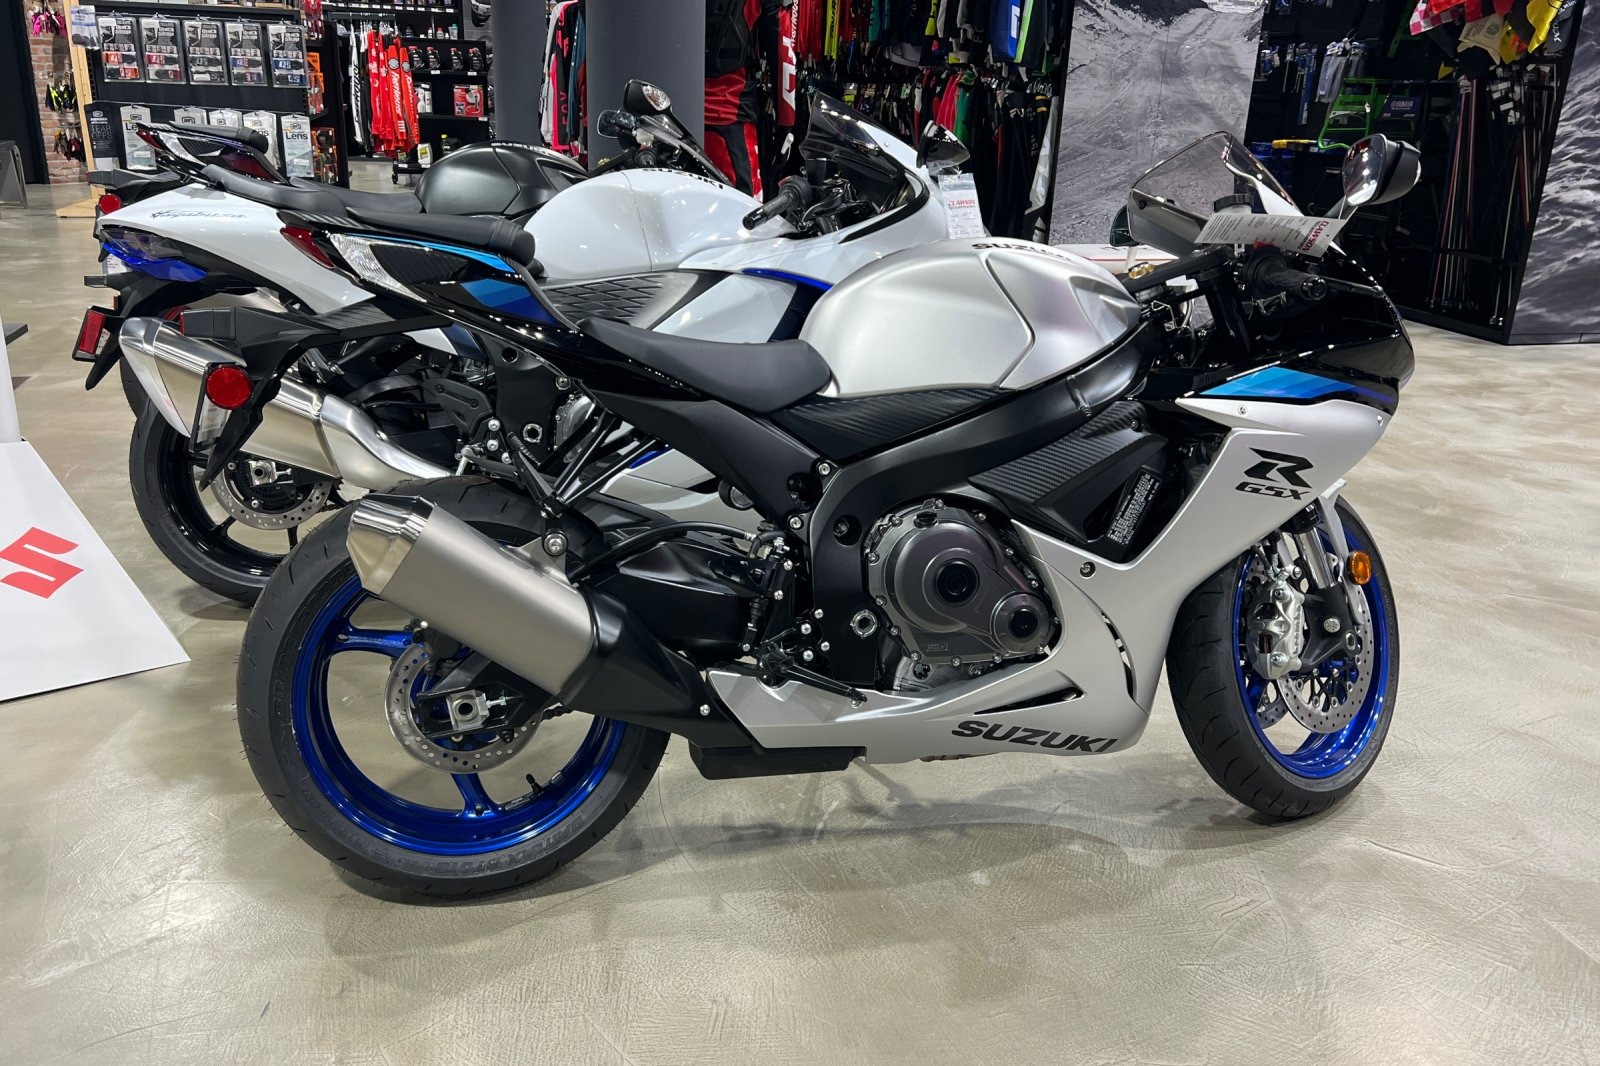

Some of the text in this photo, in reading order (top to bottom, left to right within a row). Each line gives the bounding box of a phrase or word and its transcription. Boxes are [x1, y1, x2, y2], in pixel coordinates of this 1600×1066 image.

[125, 122, 138, 131] Le
[285, 131, 309, 140] Lens
[1301, 220, 1330, 252] CLAWSON
[1243, 446, 1315, 489] R
[1235, 481, 1311, 501] GSX
[951, 720, 1119, 753] SUZUKI
